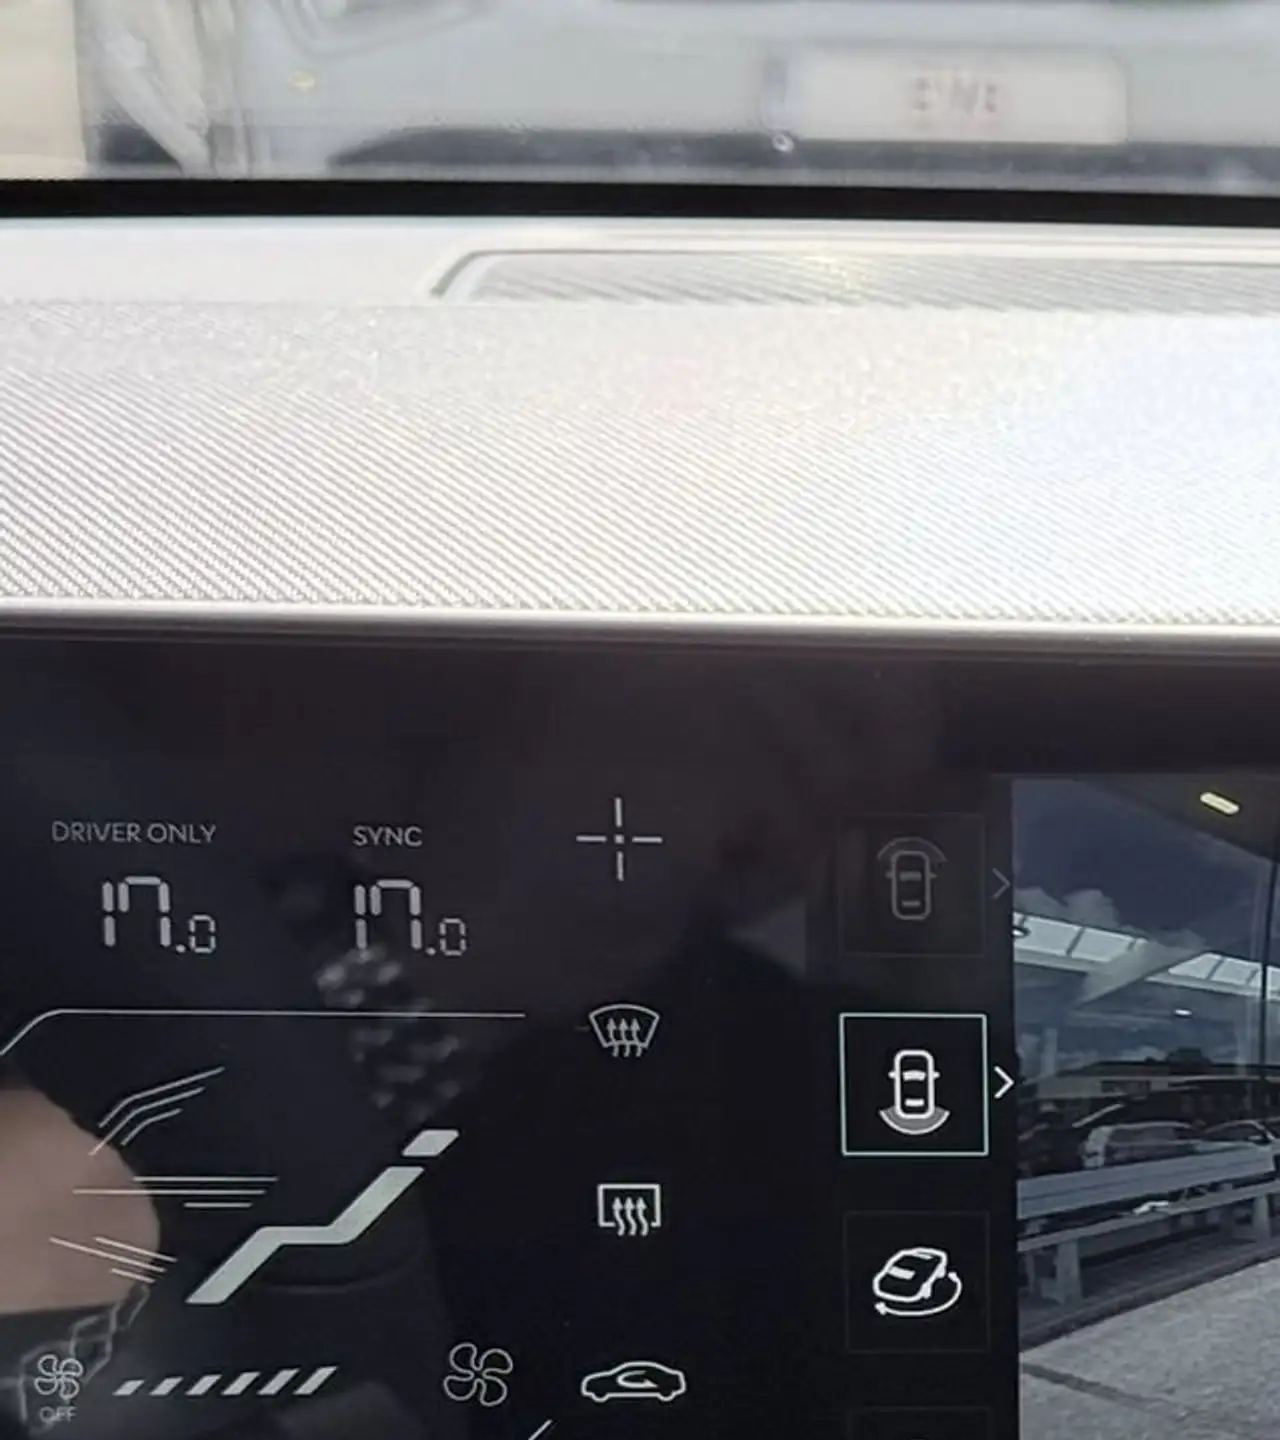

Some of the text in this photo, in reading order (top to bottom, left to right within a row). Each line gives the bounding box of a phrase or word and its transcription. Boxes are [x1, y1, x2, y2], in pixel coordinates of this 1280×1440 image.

[51, 820, 217, 844] DRIVER ONLY
[353, 825, 424, 848] SYNC
[102, 875, 217, 954] 17.0
[353, 879, 467, 956] 17.0
[39, 1406, 77, 1422] OFF
